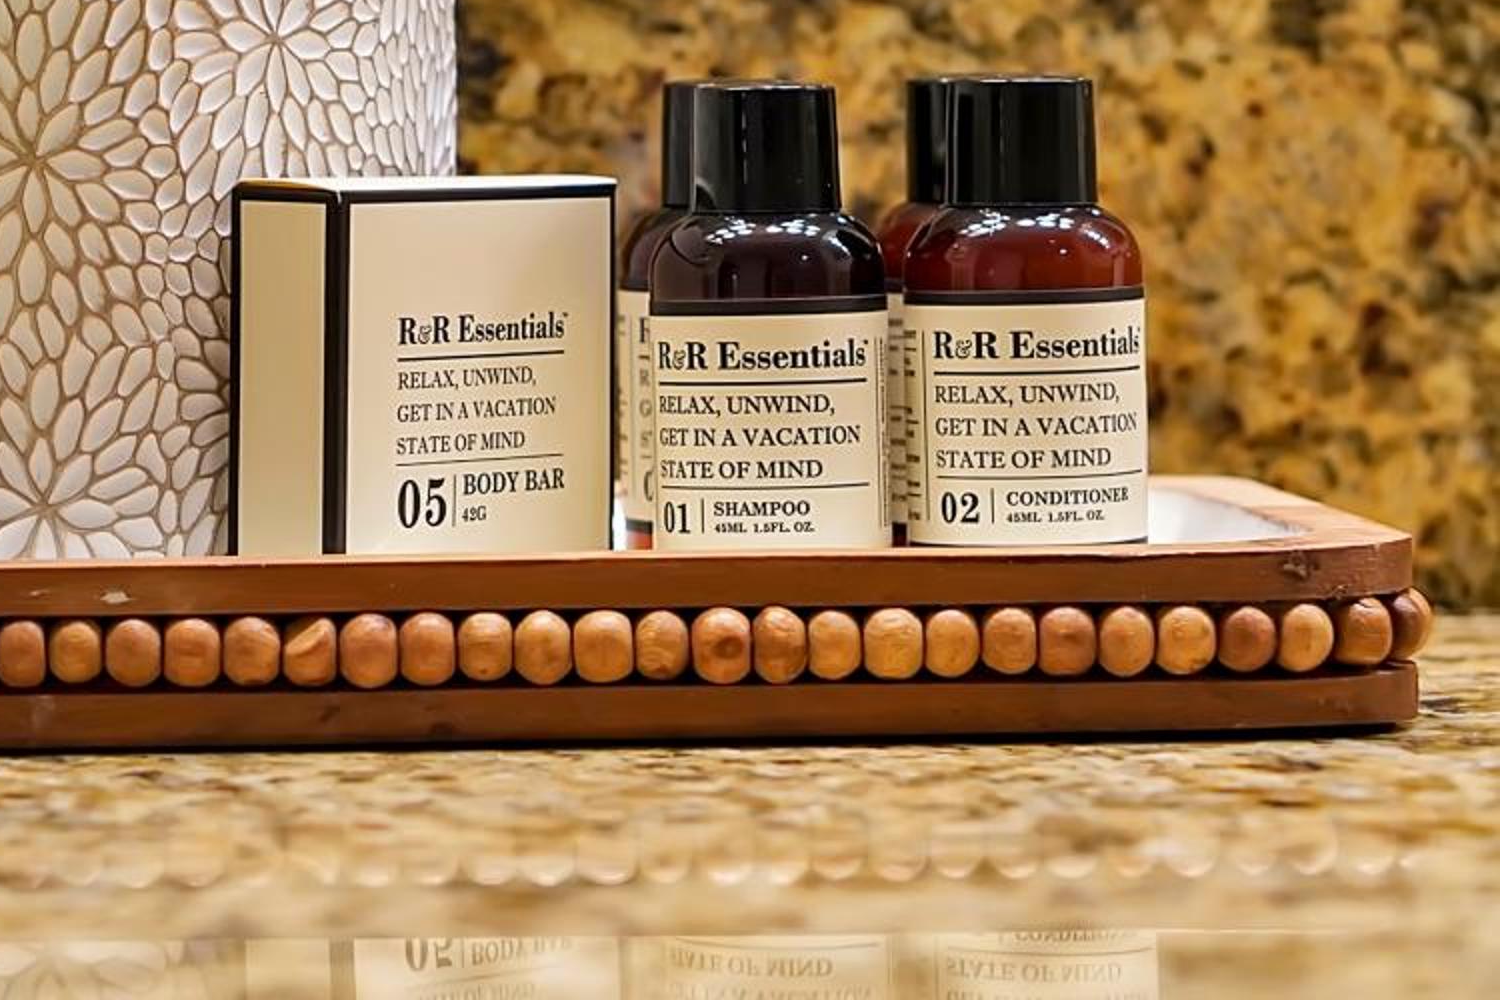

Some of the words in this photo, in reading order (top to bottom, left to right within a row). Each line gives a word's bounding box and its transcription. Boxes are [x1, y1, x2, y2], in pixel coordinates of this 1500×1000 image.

[397, 315, 450, 344] R&R
[458, 311, 565, 343] Essentials
[658, 341, 708, 371] R&R
[718, 338, 867, 371] Essentials
[933, 331, 999, 359] R&R
[397, 369, 459, 390] RELAX,
[463, 366, 536, 388] UNWIND,
[659, 396, 721, 417] RELAX,
[726, 394, 835, 415] UNWIND,
[934, 386, 1013, 407] RELAX,
[1020, 382, 1120, 404] UNWIND,
[397, 404, 432, 423] GET
[435, 403, 455, 421] IN
[457, 402, 470, 420] A
[474, 396, 557, 418] VACATION
[659, 428, 689, 446] GET
[693, 428, 715, 446] IN
[721, 428, 737, 446] A
[742, 425, 861, 446] VACATION
[935, 418, 977, 436] GET
[983, 418, 1008, 436] IN
[1014, 418, 1031, 436] A
[1036, 412, 1138, 436] VACATION
[396, 434, 451, 455] STATE
[454, 433, 477, 452] OF
[480, 431, 525, 451] MIND
[661, 460, 714, 479] STATE
[718, 460, 750, 479] OF
[756, 459, 823, 478] MIND
[936, 450, 1006, 470] STATE
[1011, 450, 1045, 469] OF
[1051, 448, 1111, 467] MIND
[397, 478, 447, 529] 05
[463, 471, 519, 495] BODY
[525, 468, 565, 491] BAR
[941, 491, 980, 524] 02
[664, 501, 691, 534] 01
[713, 500, 811, 517] SHAMPOO
